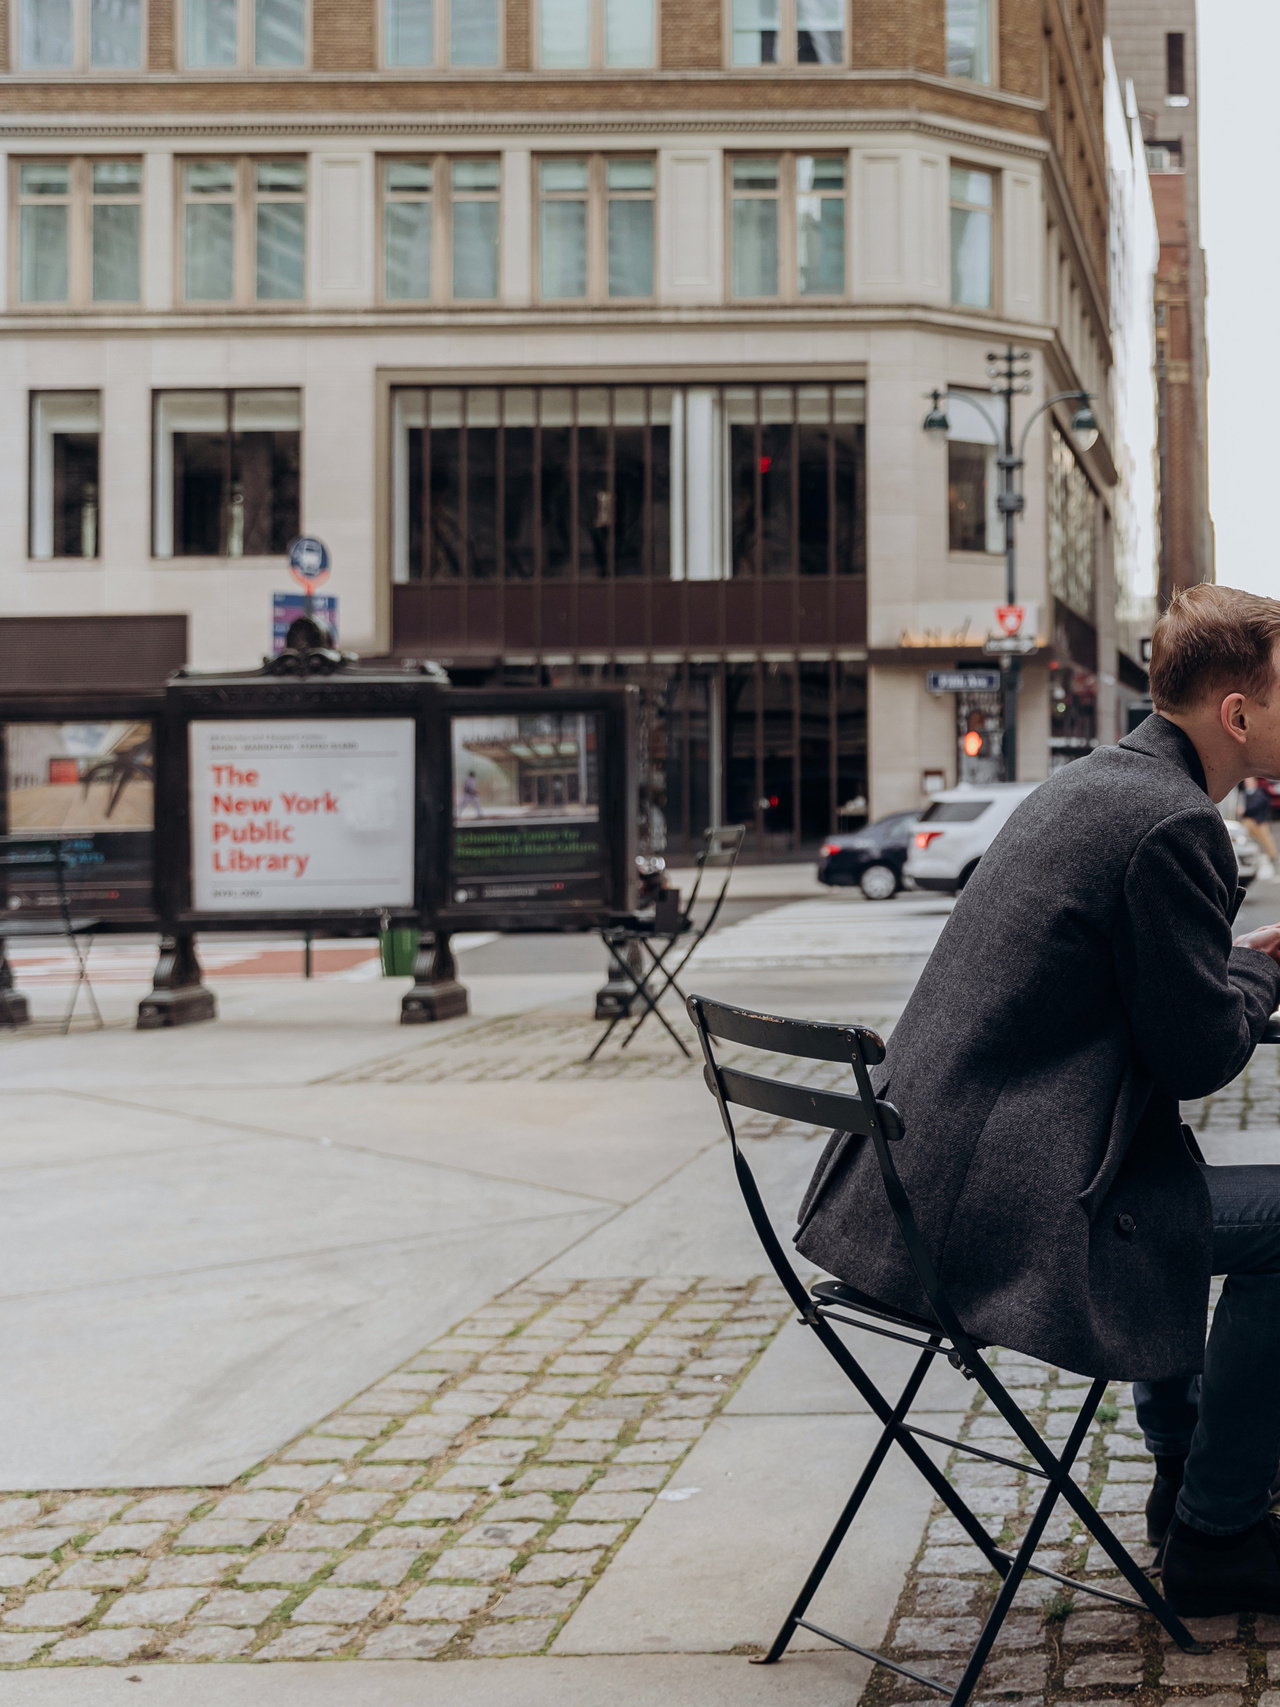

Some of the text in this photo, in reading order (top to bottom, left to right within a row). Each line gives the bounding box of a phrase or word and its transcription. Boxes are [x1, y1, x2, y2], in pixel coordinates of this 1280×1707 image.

[211, 764, 260, 787] The
[212, 791, 339, 815] New York
[212, 820, 296, 843] Public
[212, 849, 310, 878] Library
